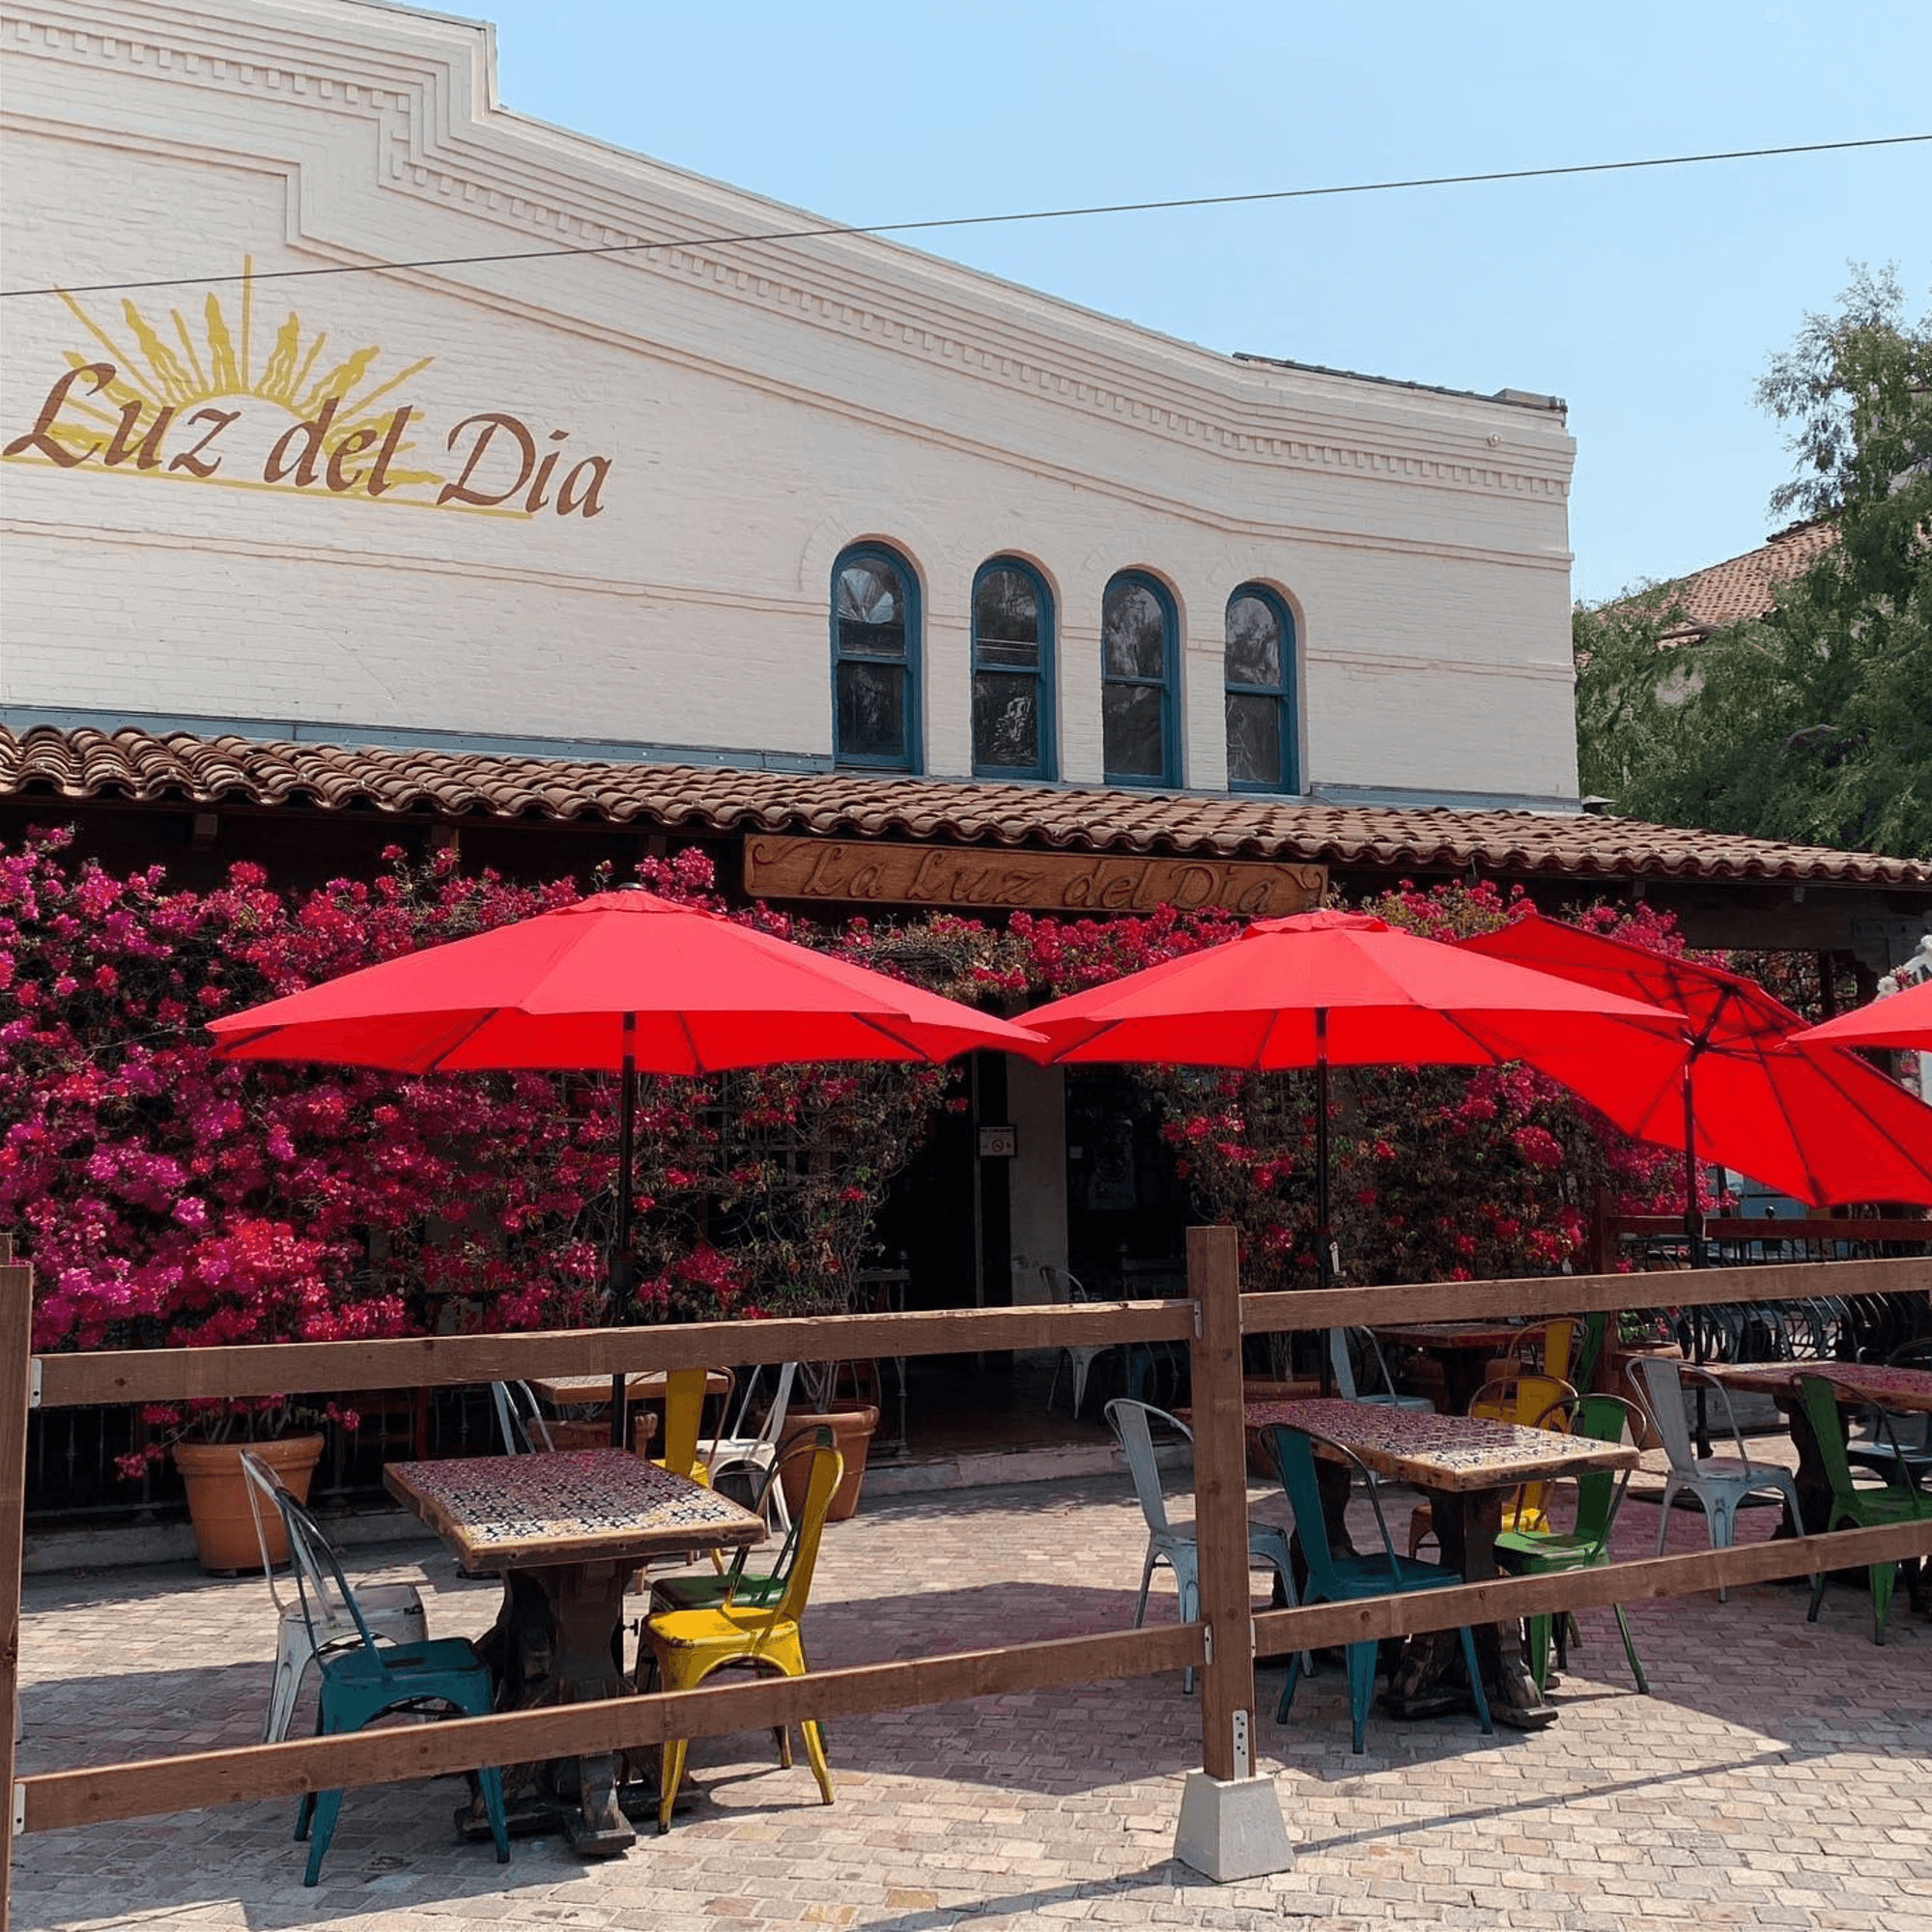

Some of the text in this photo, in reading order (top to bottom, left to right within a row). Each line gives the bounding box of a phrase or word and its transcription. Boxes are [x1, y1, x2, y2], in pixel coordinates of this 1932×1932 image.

[3, 363, 242, 479] Luz
[265, 397, 413, 497] del
[800, 844, 887, 898] La
[904, 849, 1046, 905] Luz
[1063, 860, 1159, 910] del
